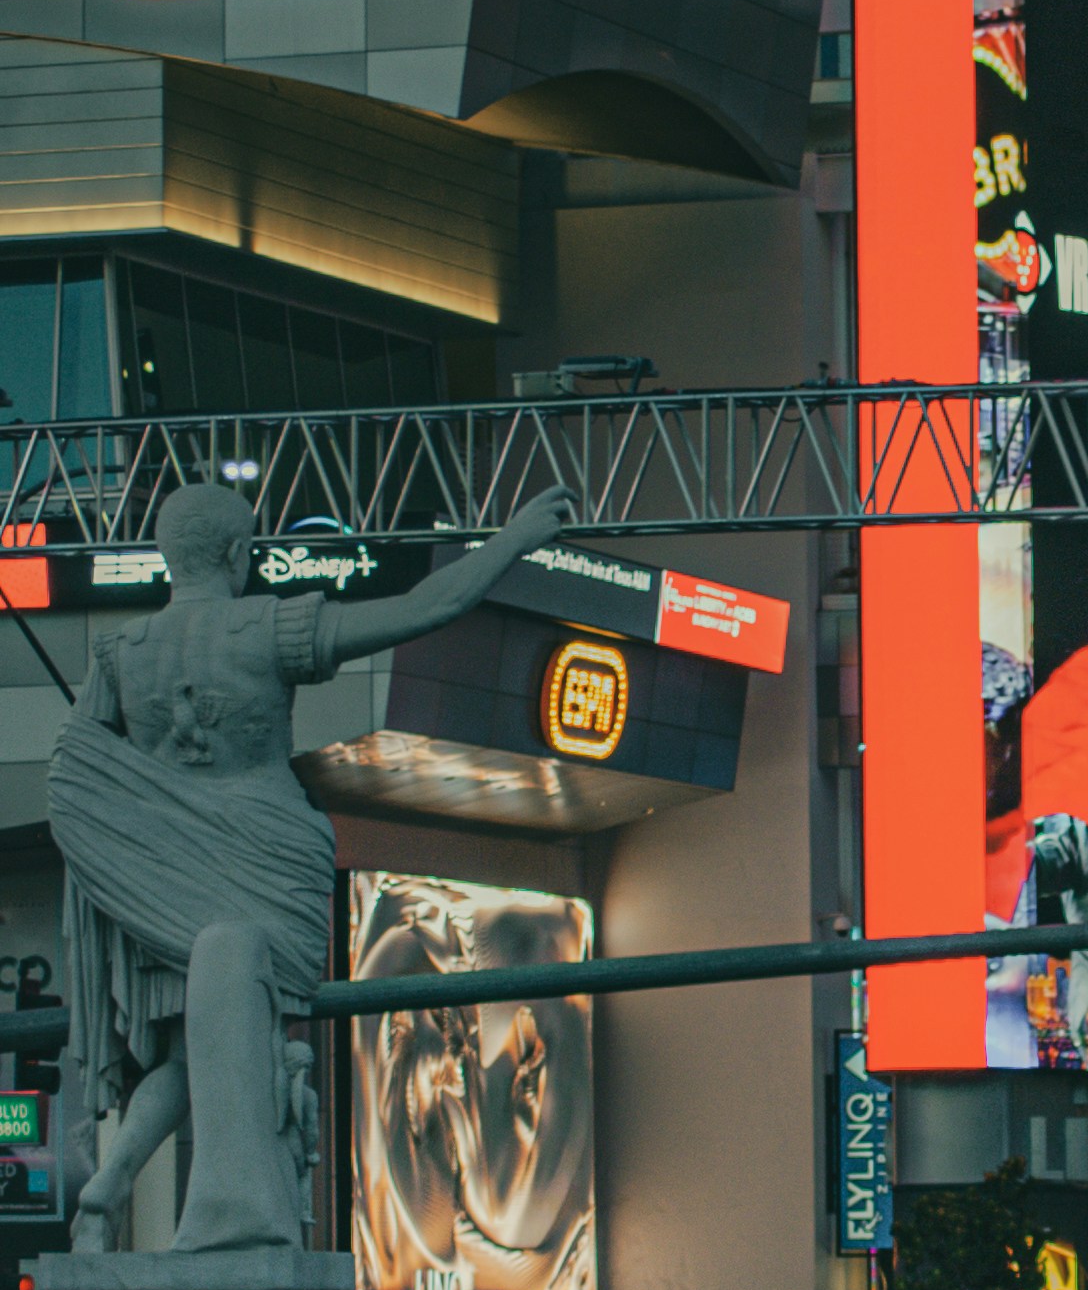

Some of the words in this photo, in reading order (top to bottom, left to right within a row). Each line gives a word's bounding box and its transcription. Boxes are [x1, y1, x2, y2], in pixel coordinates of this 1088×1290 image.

[92, 554, 171, 585] ESP
[562, 668, 616, 733] ESPN
[847, 1092, 874, 1240] FLYLINQ
